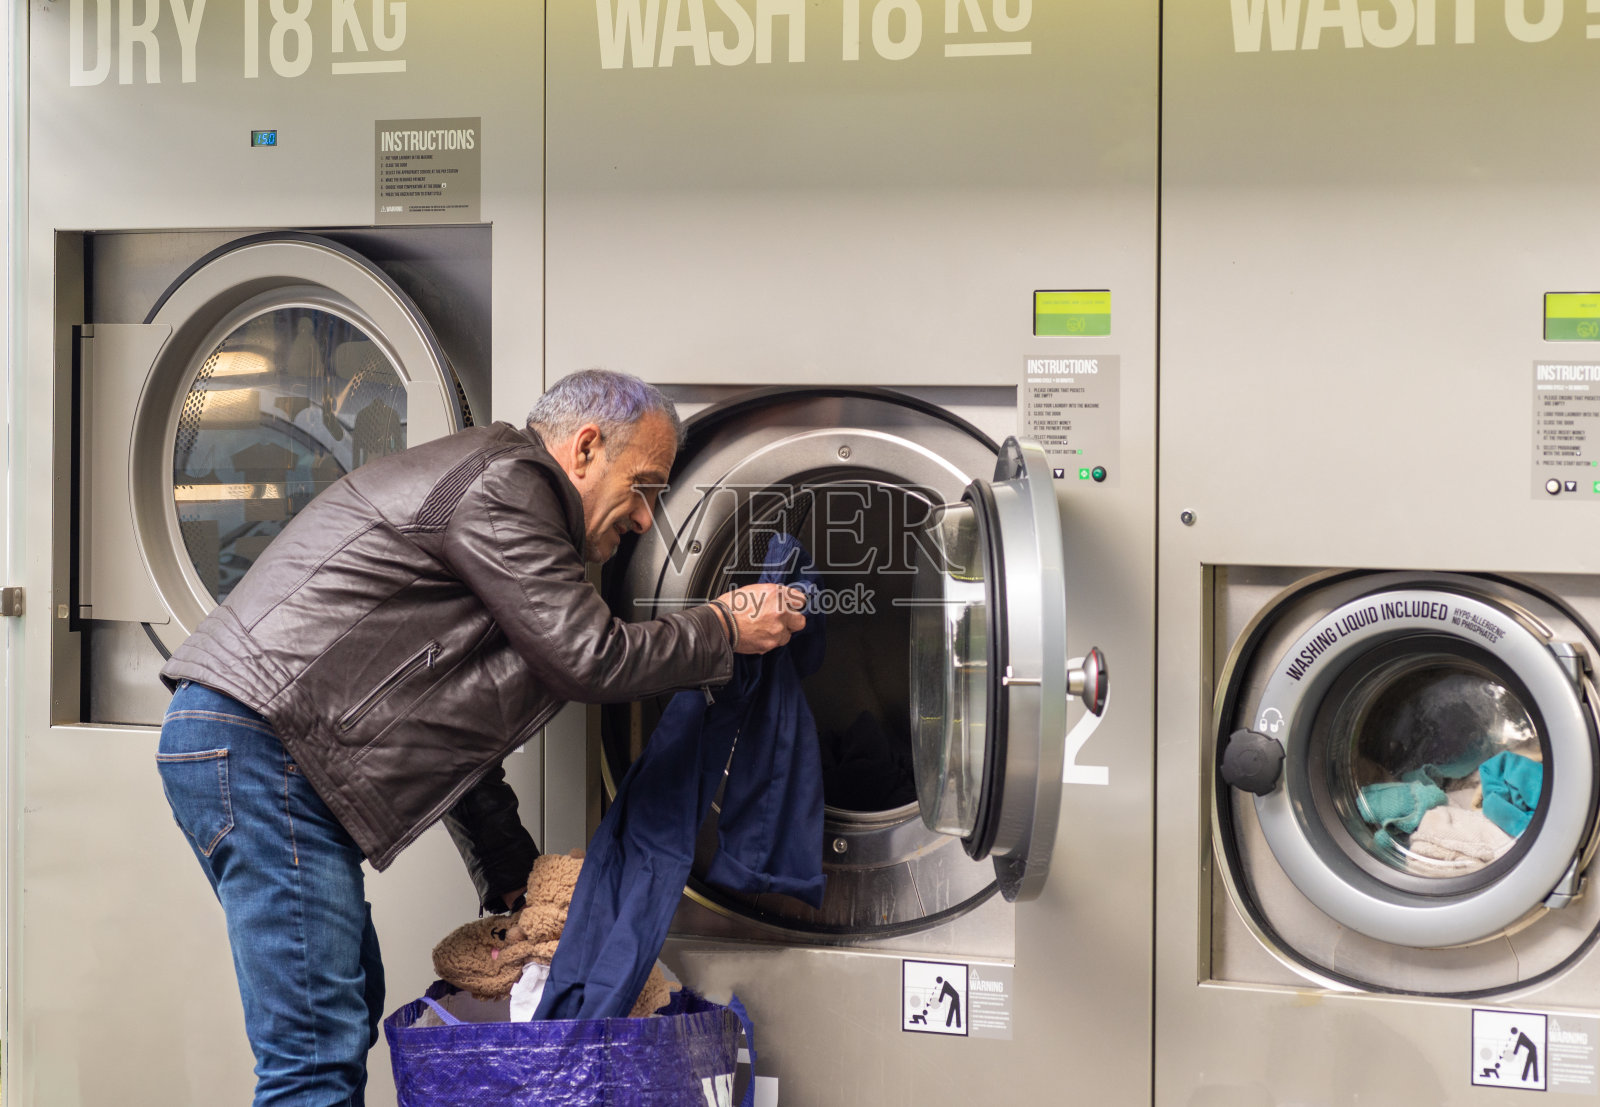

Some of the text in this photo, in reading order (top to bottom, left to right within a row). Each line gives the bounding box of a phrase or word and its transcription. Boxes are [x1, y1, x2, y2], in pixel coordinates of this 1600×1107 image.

[69, 0, 407, 87] DRY 18 KG
[381, 128, 475, 152] INSTRUCTIONS
[1028, 360, 1098, 374] INSTRUCTIONS
[1452, 616, 1498, 644] NO PHOSPHATES
[1454, 608, 1506, 639] HYPO-ALLERGENIC
[1286, 600, 1448, 682] WASHING LIQUID INCLUDED
[969, 979, 1004, 992] WARNING
